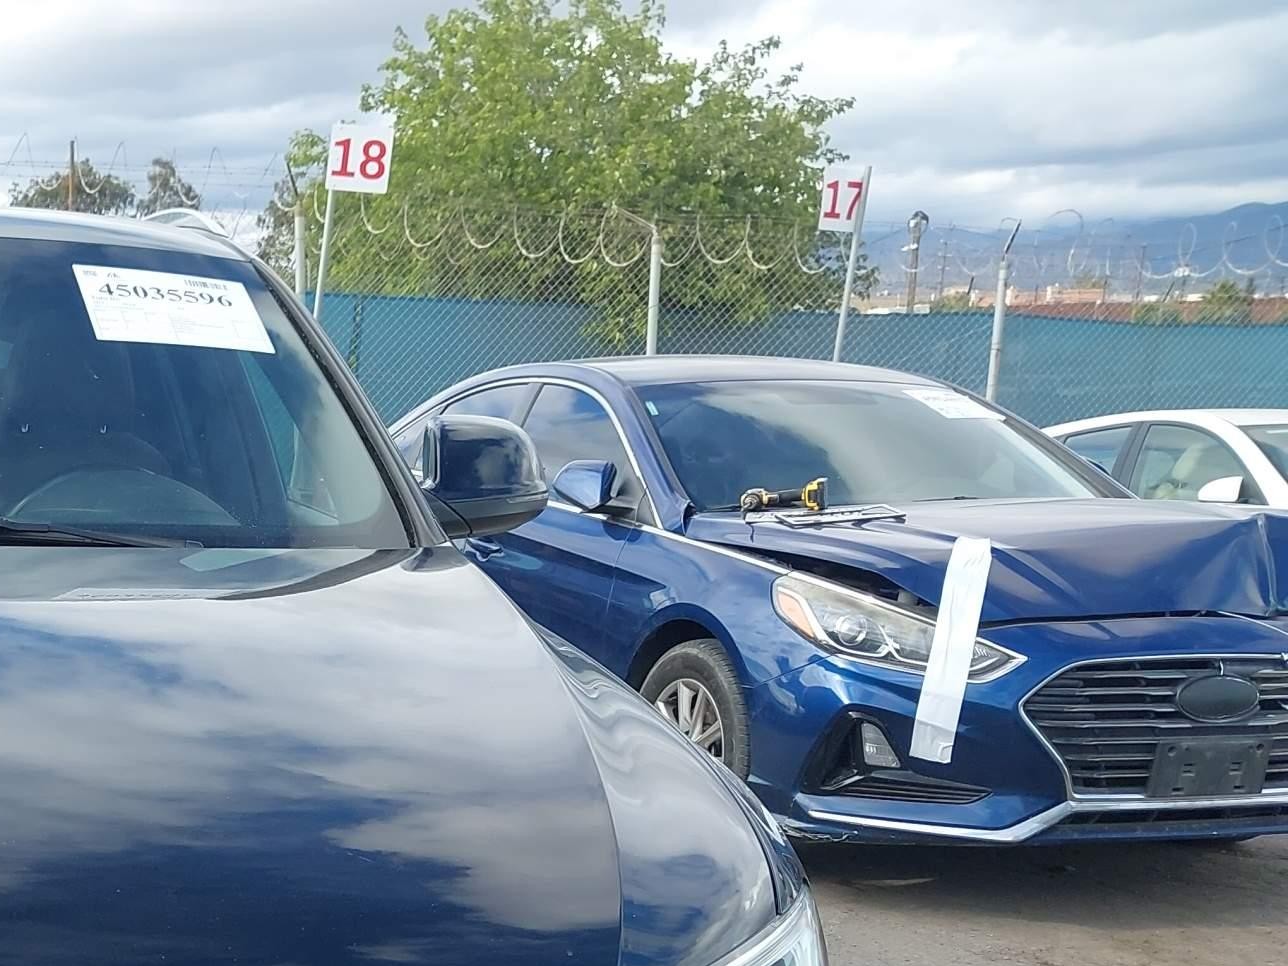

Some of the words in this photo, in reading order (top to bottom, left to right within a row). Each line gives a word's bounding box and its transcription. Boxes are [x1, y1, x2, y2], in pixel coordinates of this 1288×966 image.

[331, 138, 387, 180] 18
[823, 180, 863, 220] 17
[98, 282, 233, 308] 45035596
